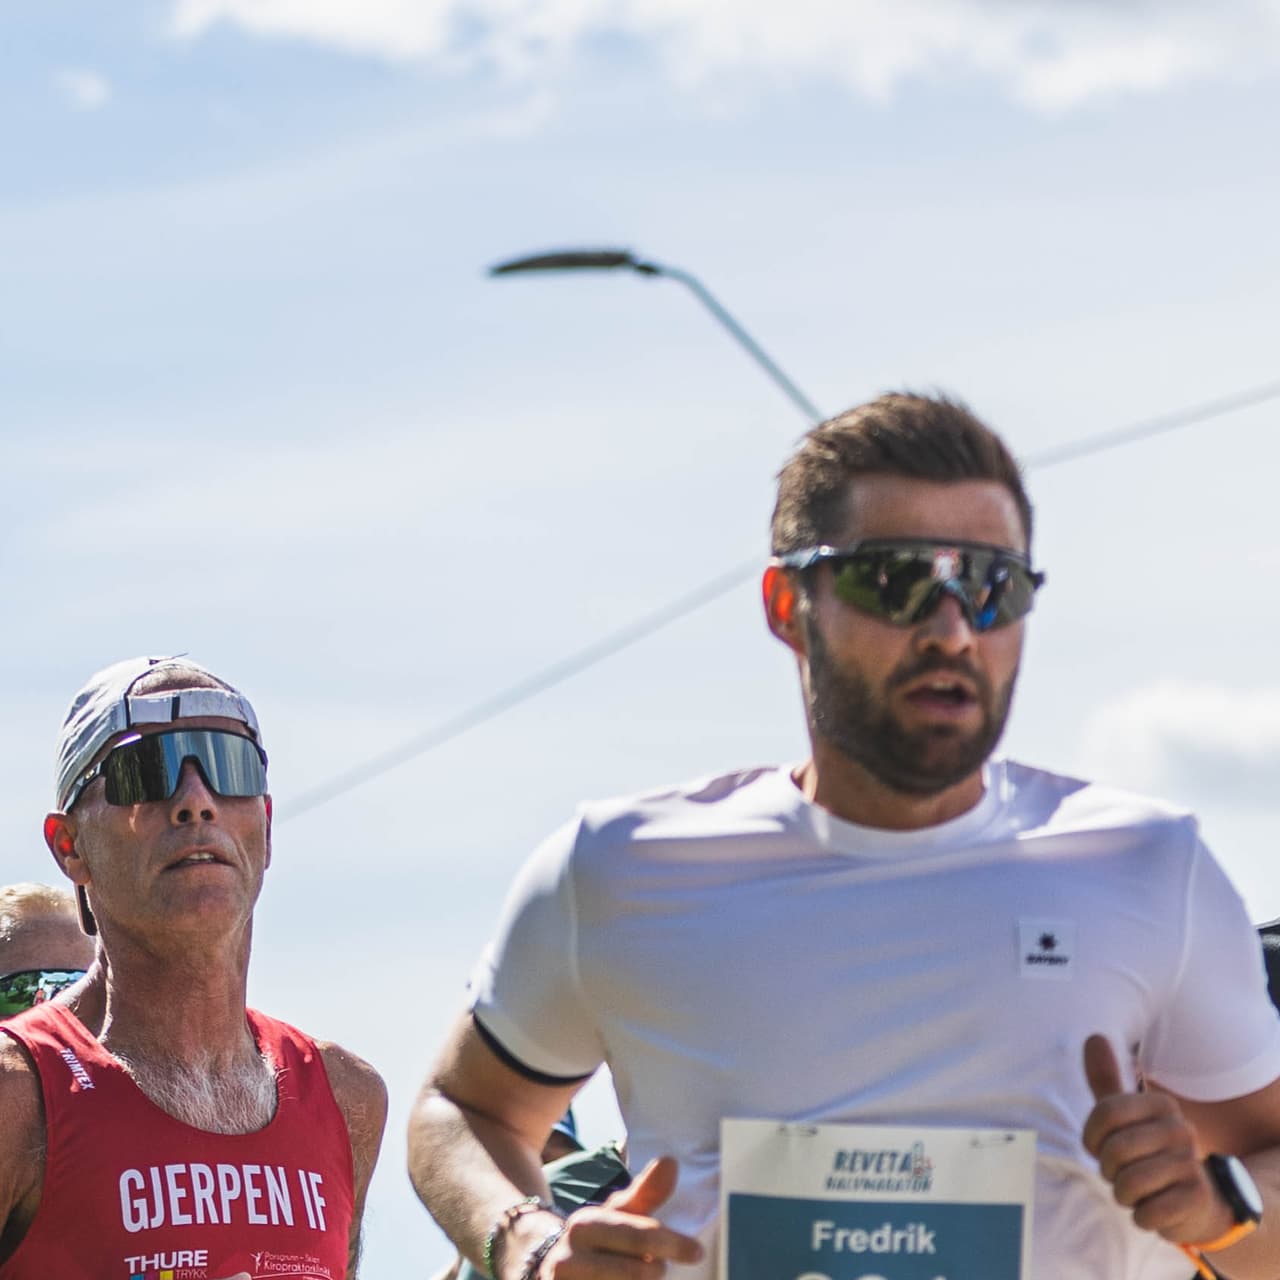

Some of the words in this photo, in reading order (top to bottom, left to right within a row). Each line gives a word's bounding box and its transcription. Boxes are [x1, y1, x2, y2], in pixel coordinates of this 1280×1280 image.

[60, 1048, 96, 1090] TRIMTEX
[833, 1151, 913, 1174] REVETA
[119, 1163, 294, 1233] GJERPEN
[298, 1169, 327, 1231] IF
[812, 1220, 937, 1254] Fredrik
[124, 1249, 208, 1274] THURE
[176, 1269, 207, 1280] TRYKK
